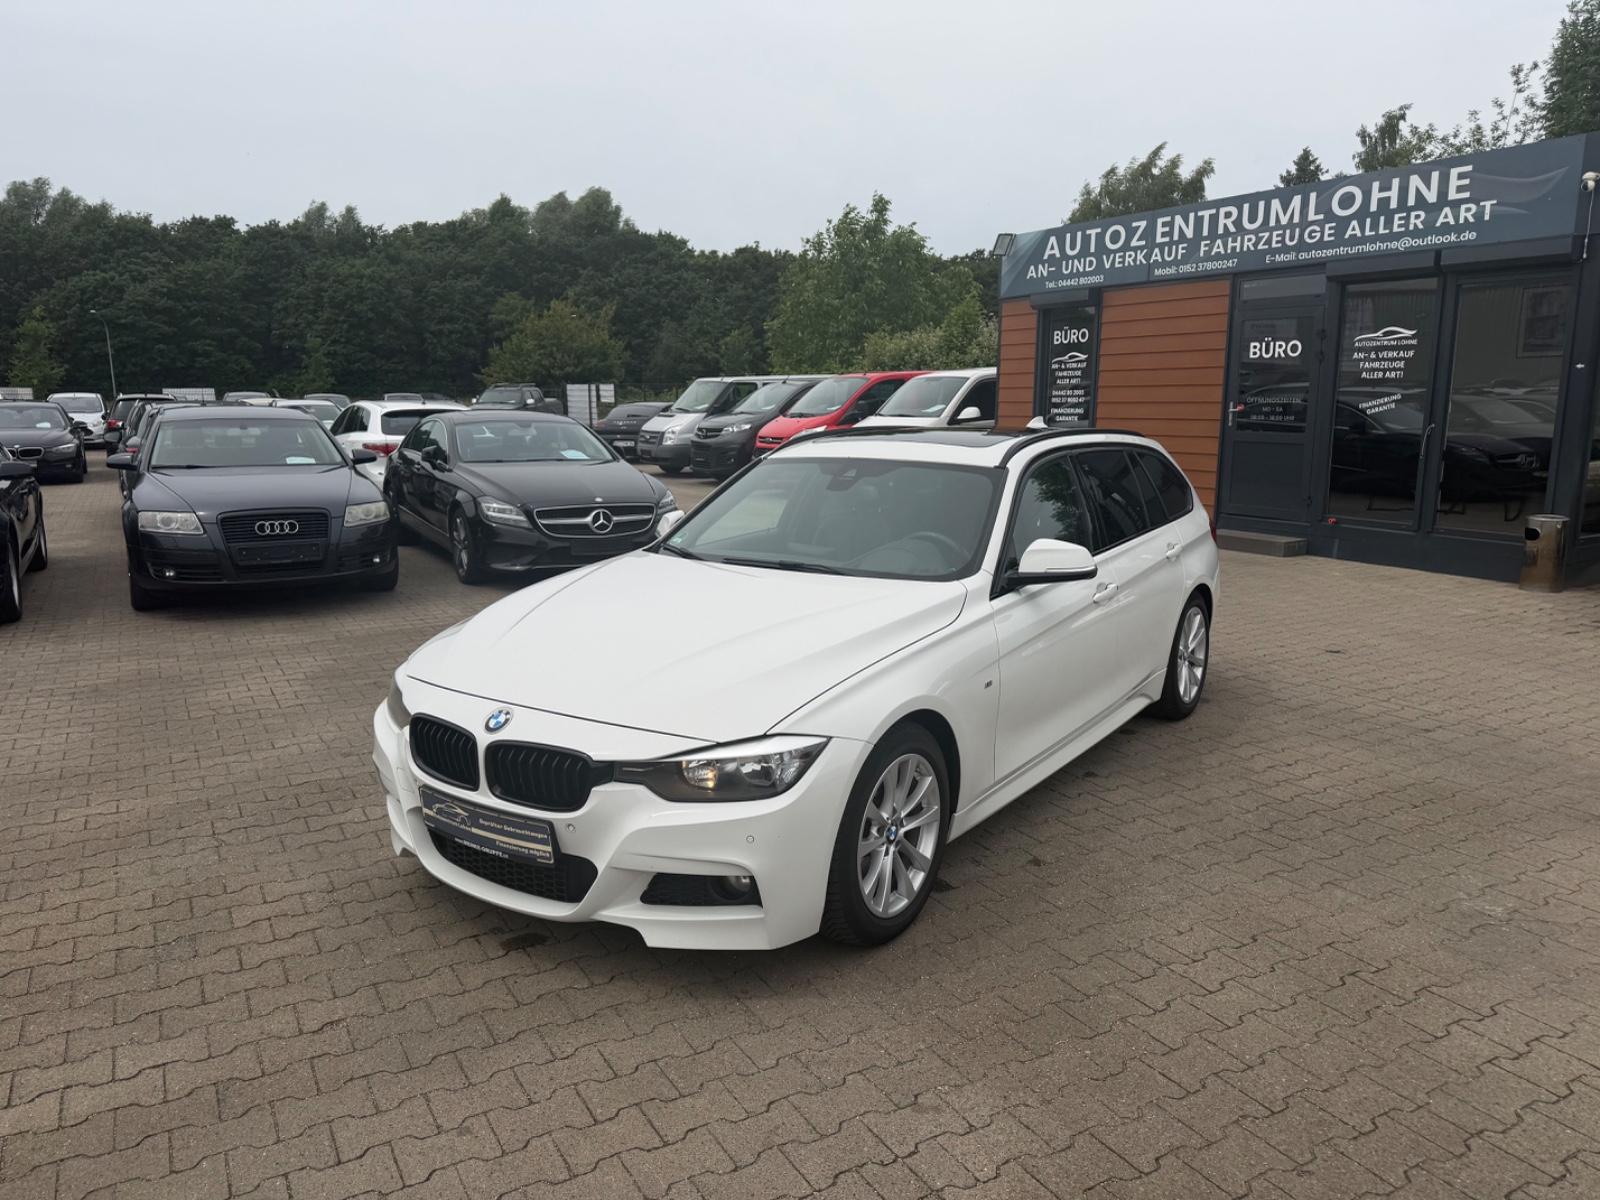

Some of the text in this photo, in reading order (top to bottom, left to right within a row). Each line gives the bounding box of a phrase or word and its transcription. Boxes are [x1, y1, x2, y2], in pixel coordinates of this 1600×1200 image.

[1026, 200, 1498, 280] AN- UND VERKAUF FAHRZEUGE ALLER ART
[1265, 230, 1477, 263] E-Mail: autozentrumlohne@outlook.de
[1154, 259, 1239, 277] Mobil: 0152 37800247
[1058, 277, 1078, 288] 04442
[1079, 275, 1105, 286] 802003
[1053, 326, 1089, 345] BÜRO
[1249, 337, 1303, 359] BÜRO
[1354, 340, 1397, 348] AUTOZENTRUM
[1352, 350, 1415, 360] AN- & VERKAUF
[1359, 360, 1405, 369] FAHRZEUGE
[1361, 370, 1404, 379] ALLER ART!
[1359, 393, 1402, 409] FINANZIERUNG
[1366, 402, 1396, 415] GARANTIE
